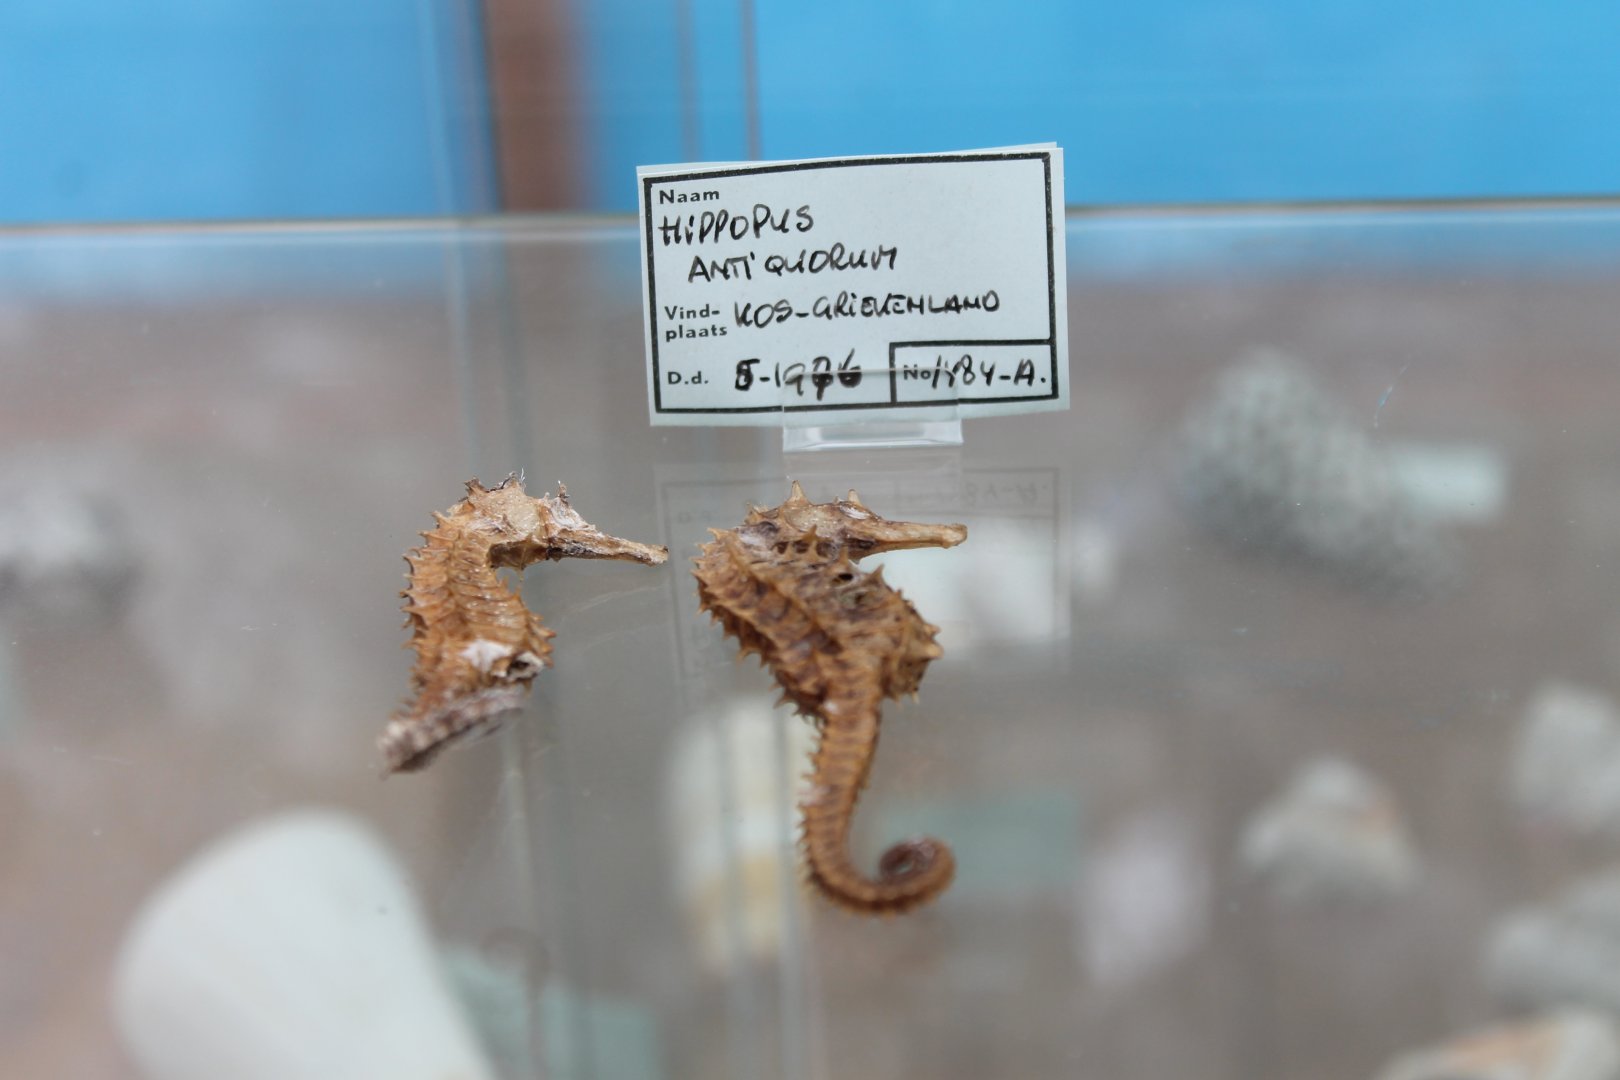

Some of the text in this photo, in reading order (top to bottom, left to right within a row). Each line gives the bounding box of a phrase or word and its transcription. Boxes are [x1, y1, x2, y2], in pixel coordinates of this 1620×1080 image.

[659, 189, 720, 204] Naam
[664, 304, 720, 321] Vind-
[665, 323, 728, 342] plaats
[667, 371, 709, 385] D.d.
